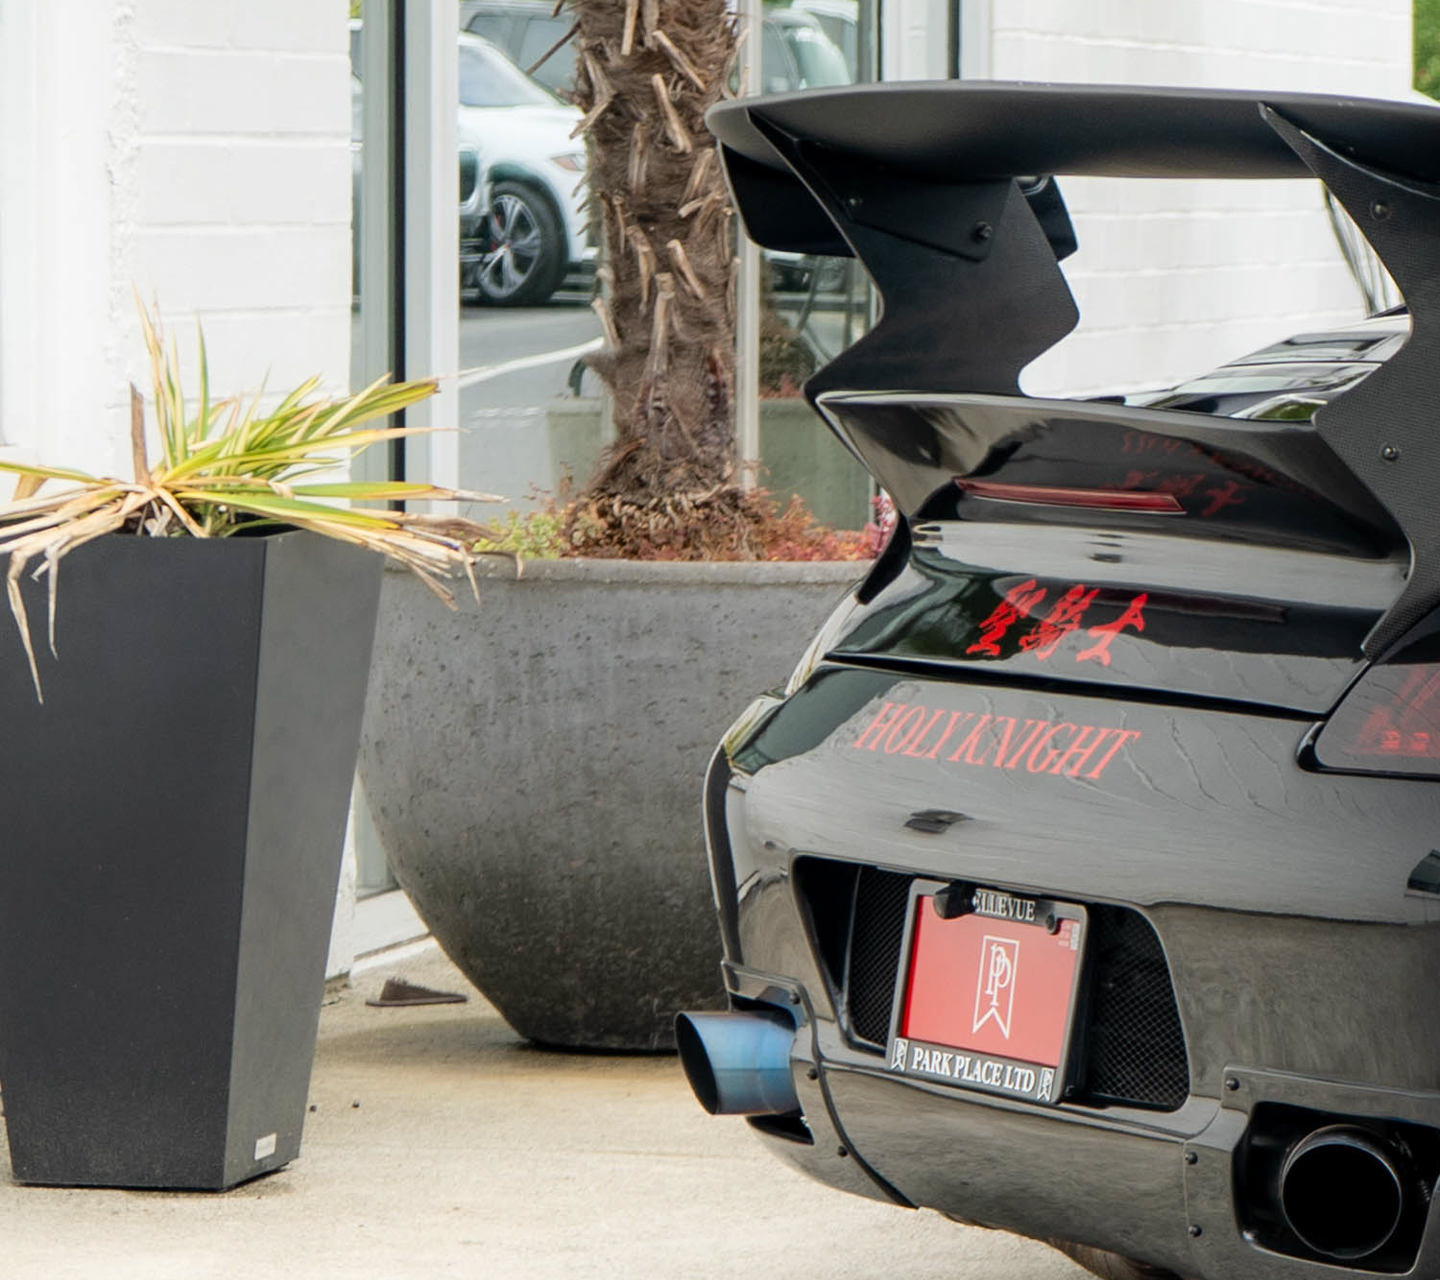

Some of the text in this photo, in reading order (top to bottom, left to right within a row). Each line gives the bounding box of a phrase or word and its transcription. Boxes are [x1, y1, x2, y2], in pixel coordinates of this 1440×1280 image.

[853, 701, 1142, 779] HOLY KNIGHT
[975, 891, 1036, 921] ELLEVUE
[912, 1046, 954, 1077] PARK
[952, 1055, 1004, 1087] PLACE
[1004, 1065, 1035, 1094] LTD
